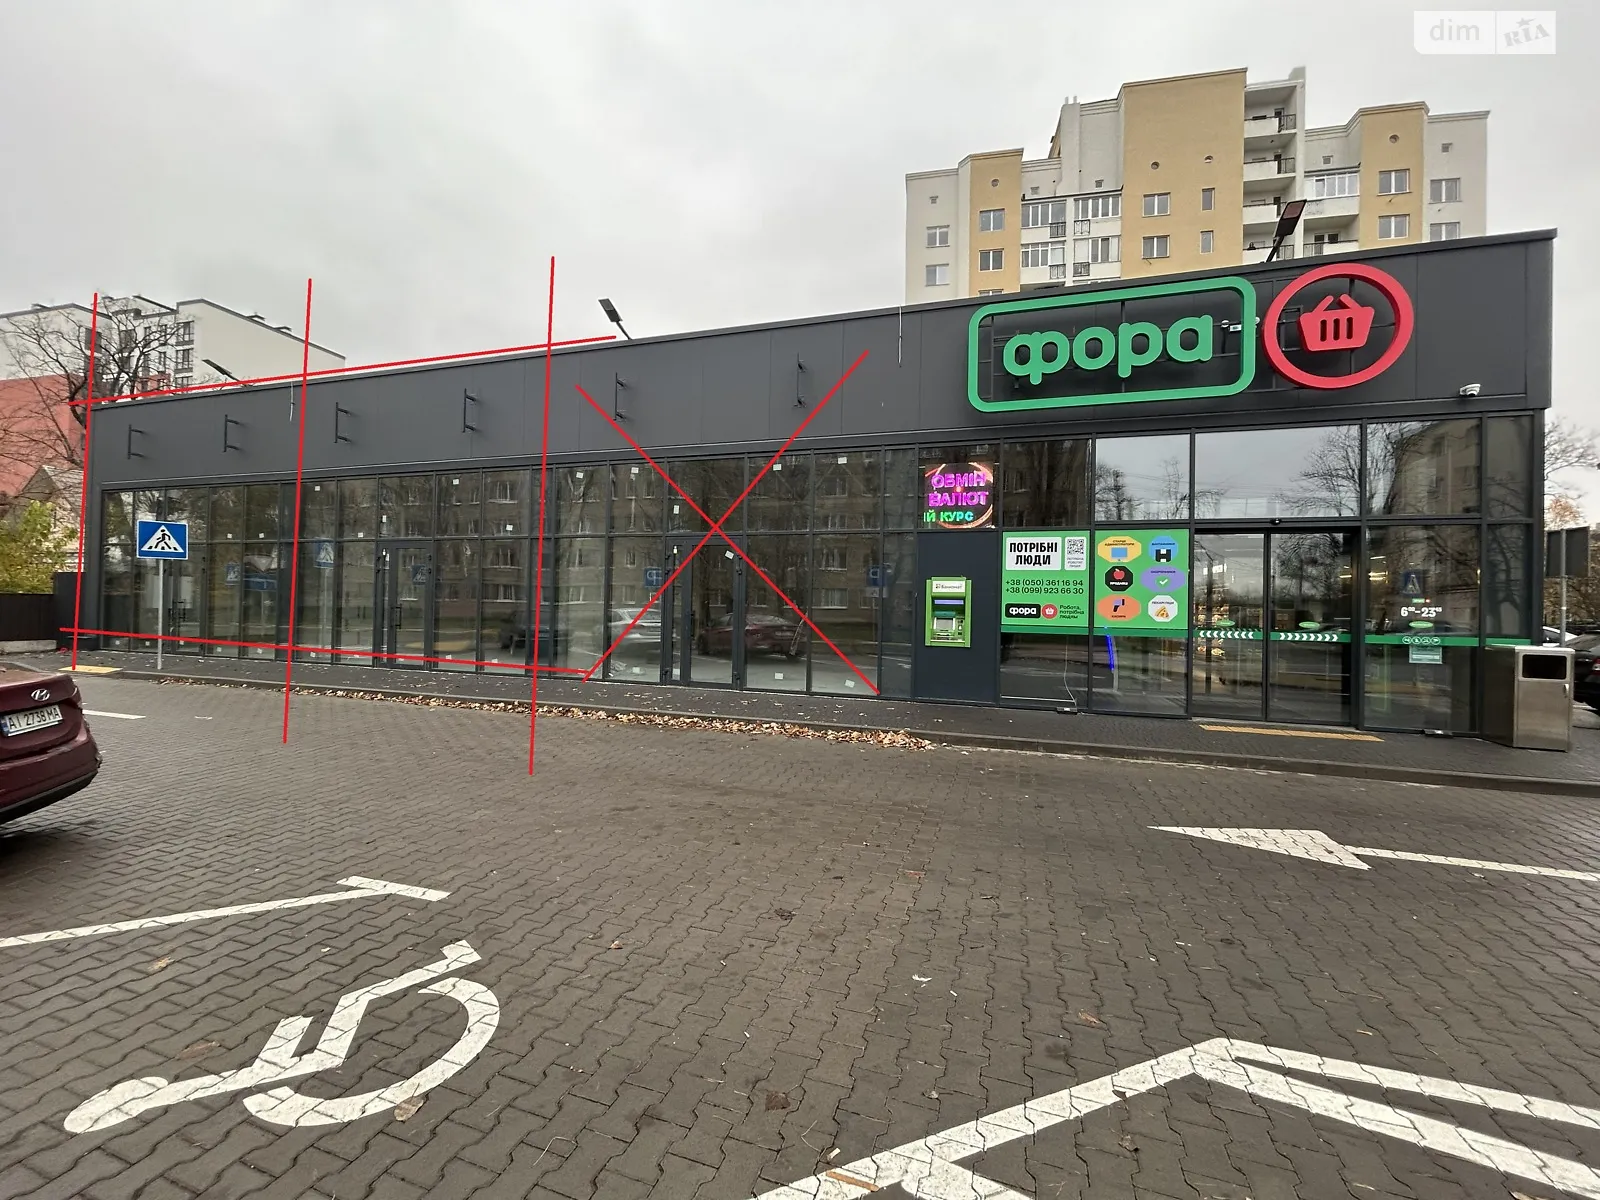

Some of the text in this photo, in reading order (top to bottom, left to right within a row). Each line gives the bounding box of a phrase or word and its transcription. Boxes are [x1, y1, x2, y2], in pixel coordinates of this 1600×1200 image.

[931, 471, 986, 488] ОБМІН
[928, 491, 989, 507] ВАЛЮТ
[940, 511, 974, 522] КУРС
[1009, 542, 1058, 553] ПОТРІБНІ
[1015, 554, 1051, 567] ЛЮДИ
[1022, 579, 1044, 587] (050)
[1045, 579, 1060, 587] 361
[1062, 579, 1071, 587] 16
[1072, 579, 1084, 587] 94
[1021, 587, 1043, 595] (099)
[1072, 587, 1084, 595] 30
[24, 710, 47, 726] 2738
